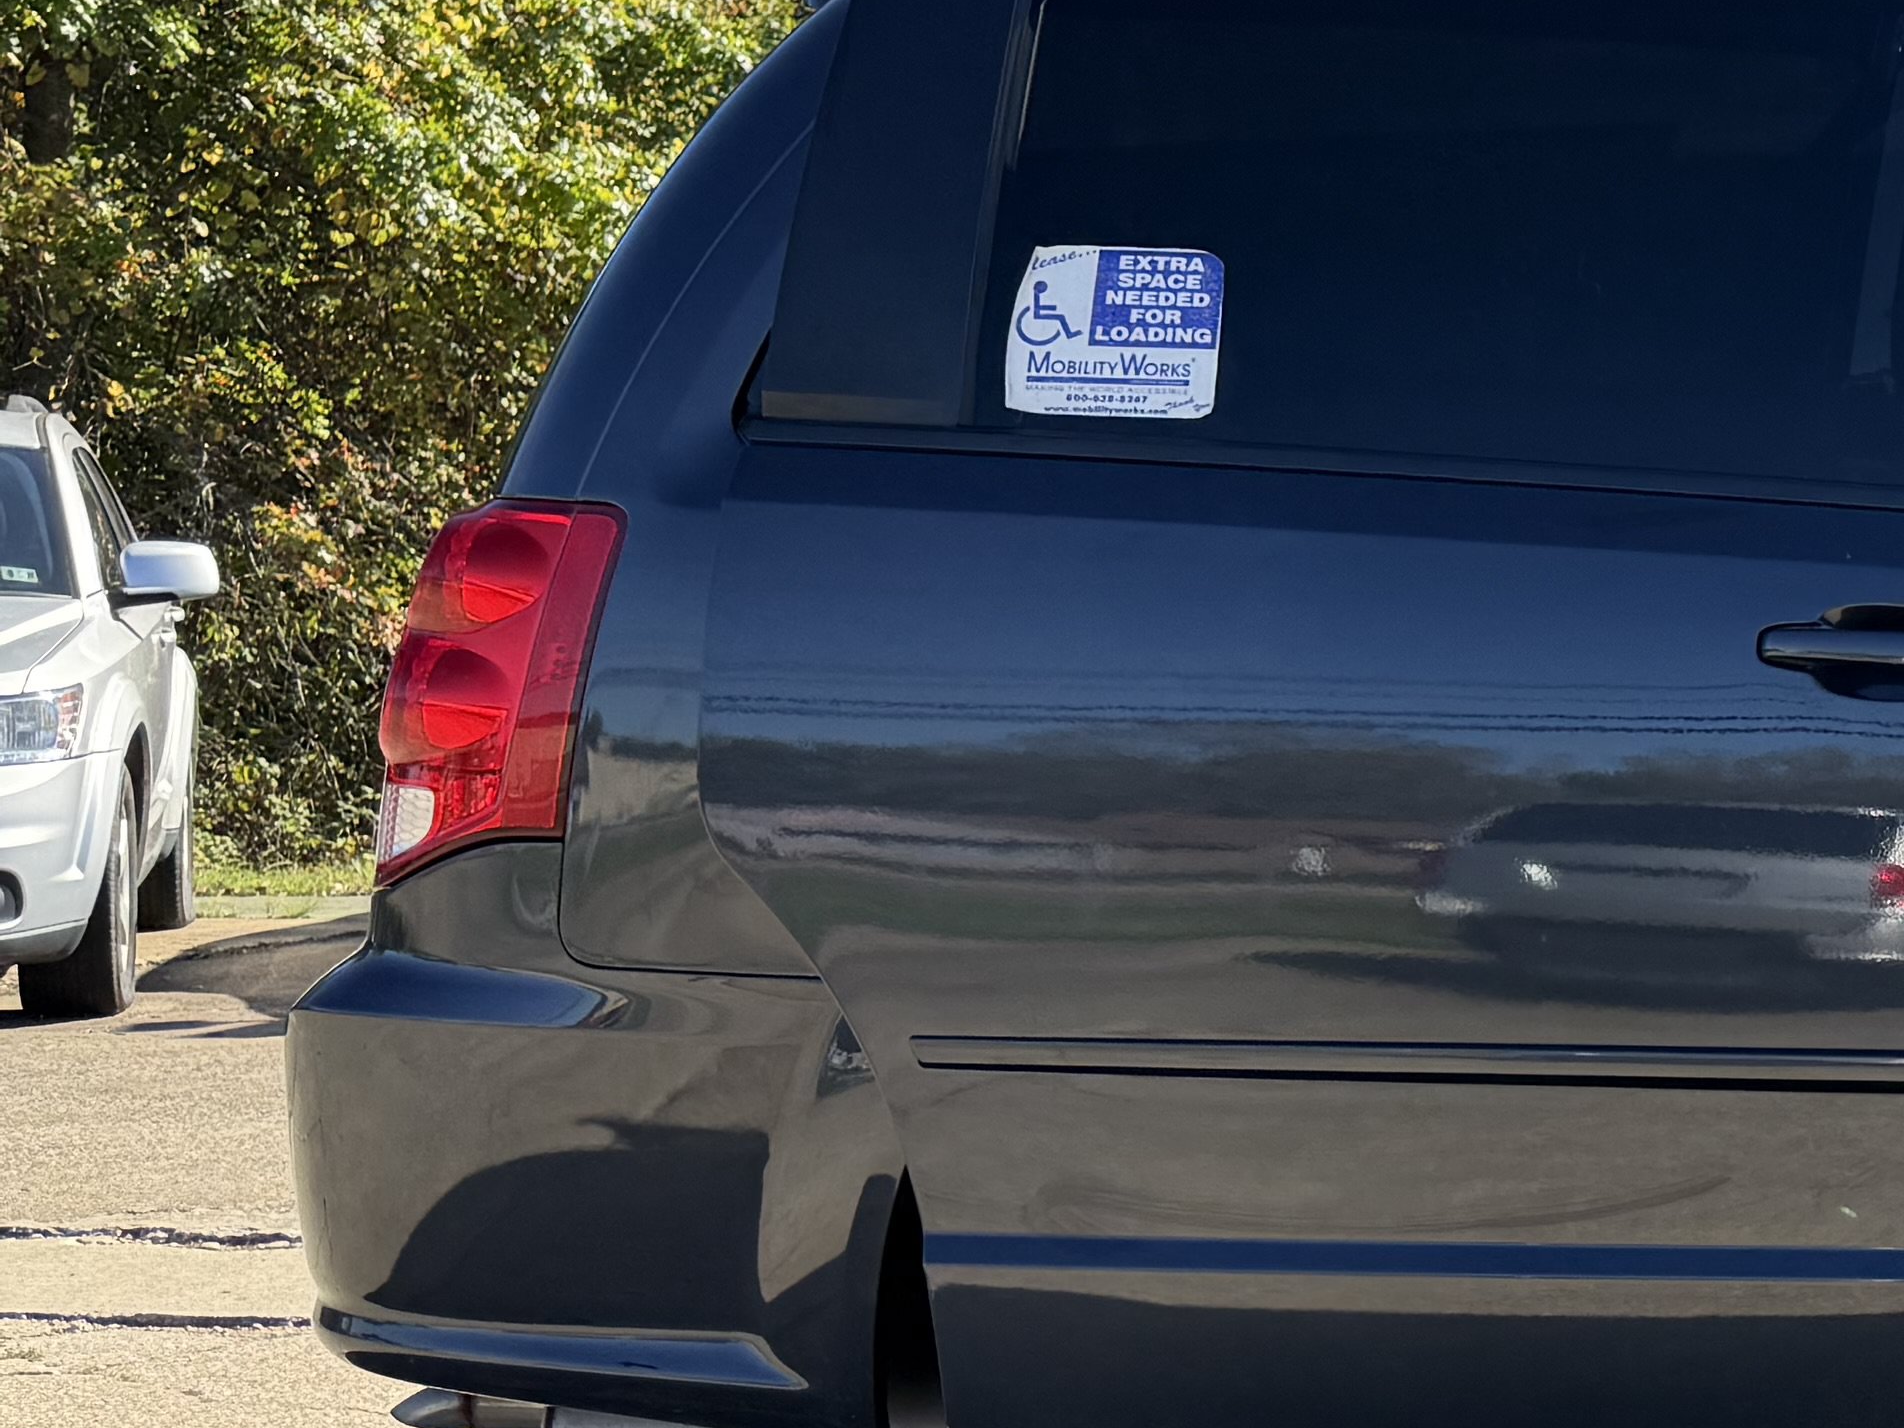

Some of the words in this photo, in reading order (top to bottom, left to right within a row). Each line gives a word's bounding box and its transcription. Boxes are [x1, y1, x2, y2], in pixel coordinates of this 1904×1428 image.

[1031, 250, 1099, 271] lease...
[1118, 255, 1205, 272] EXTRA
[1117, 273, 1202, 289] SPACE
[1105, 290, 1211, 307] NEEDED
[1129, 308, 1182, 324] FOR
[1094, 325, 1212, 344] LOADING
